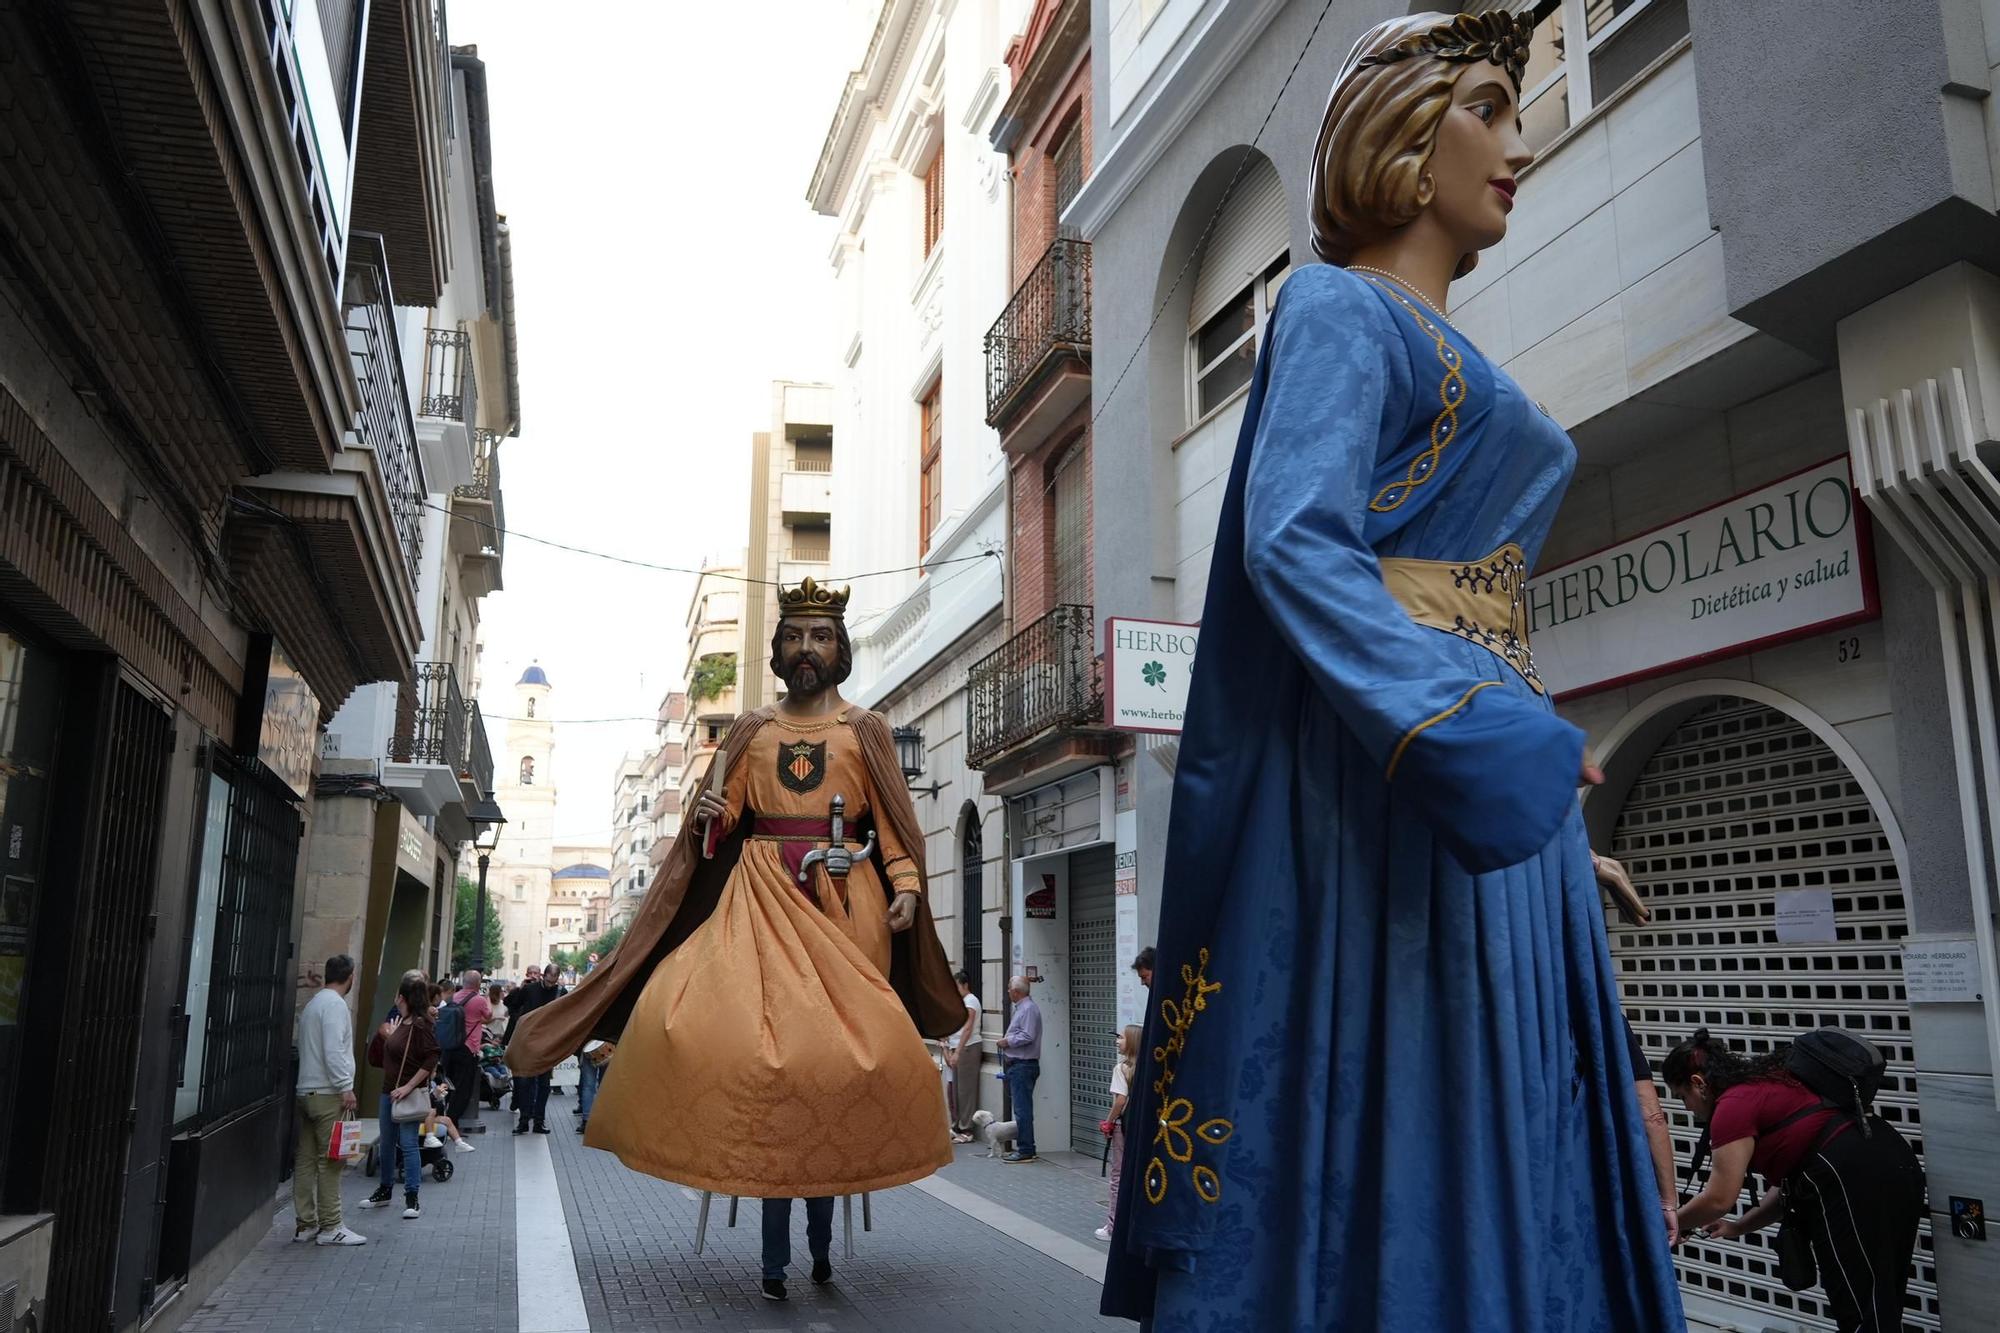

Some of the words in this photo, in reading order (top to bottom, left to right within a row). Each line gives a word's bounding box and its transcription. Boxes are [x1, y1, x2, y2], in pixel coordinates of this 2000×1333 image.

[1527, 476, 1852, 634] HERBOLARIO
[1690, 582, 1772, 620] Dietética
[1776, 576, 1789, 603] y
[1794, 550, 1850, 590] salud
[1838, 636, 1861, 664] 52
